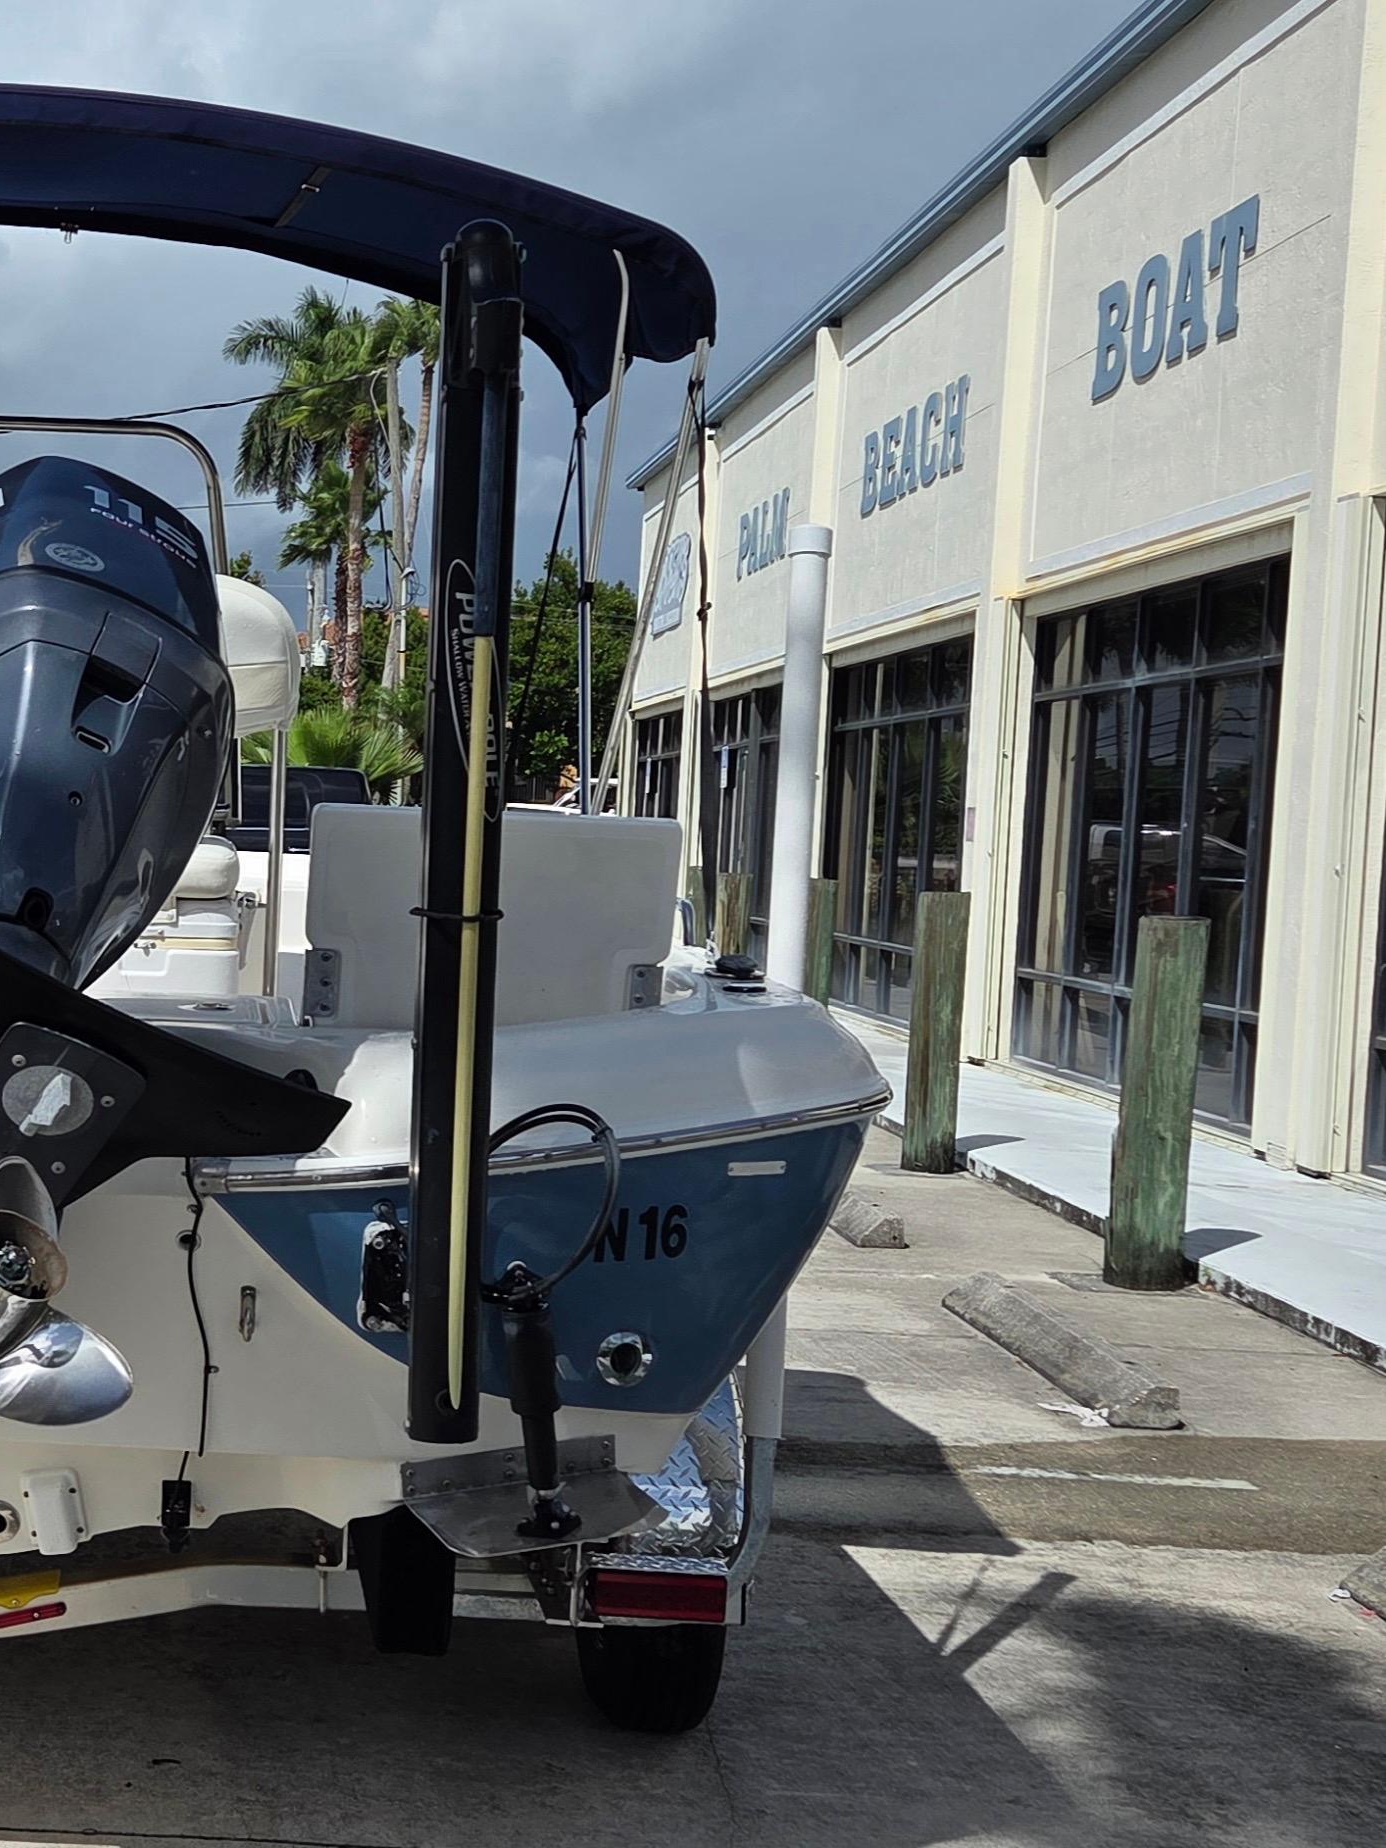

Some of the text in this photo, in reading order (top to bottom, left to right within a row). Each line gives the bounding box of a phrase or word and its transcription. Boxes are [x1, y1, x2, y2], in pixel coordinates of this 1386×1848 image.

[737, 487, 790, 581] PALM
[861, 374, 970, 518] BEACH
[1092, 194, 1260, 405] BOAT
[84, 485, 198, 559] 115
[639, 1205, 688, 1260] 16
